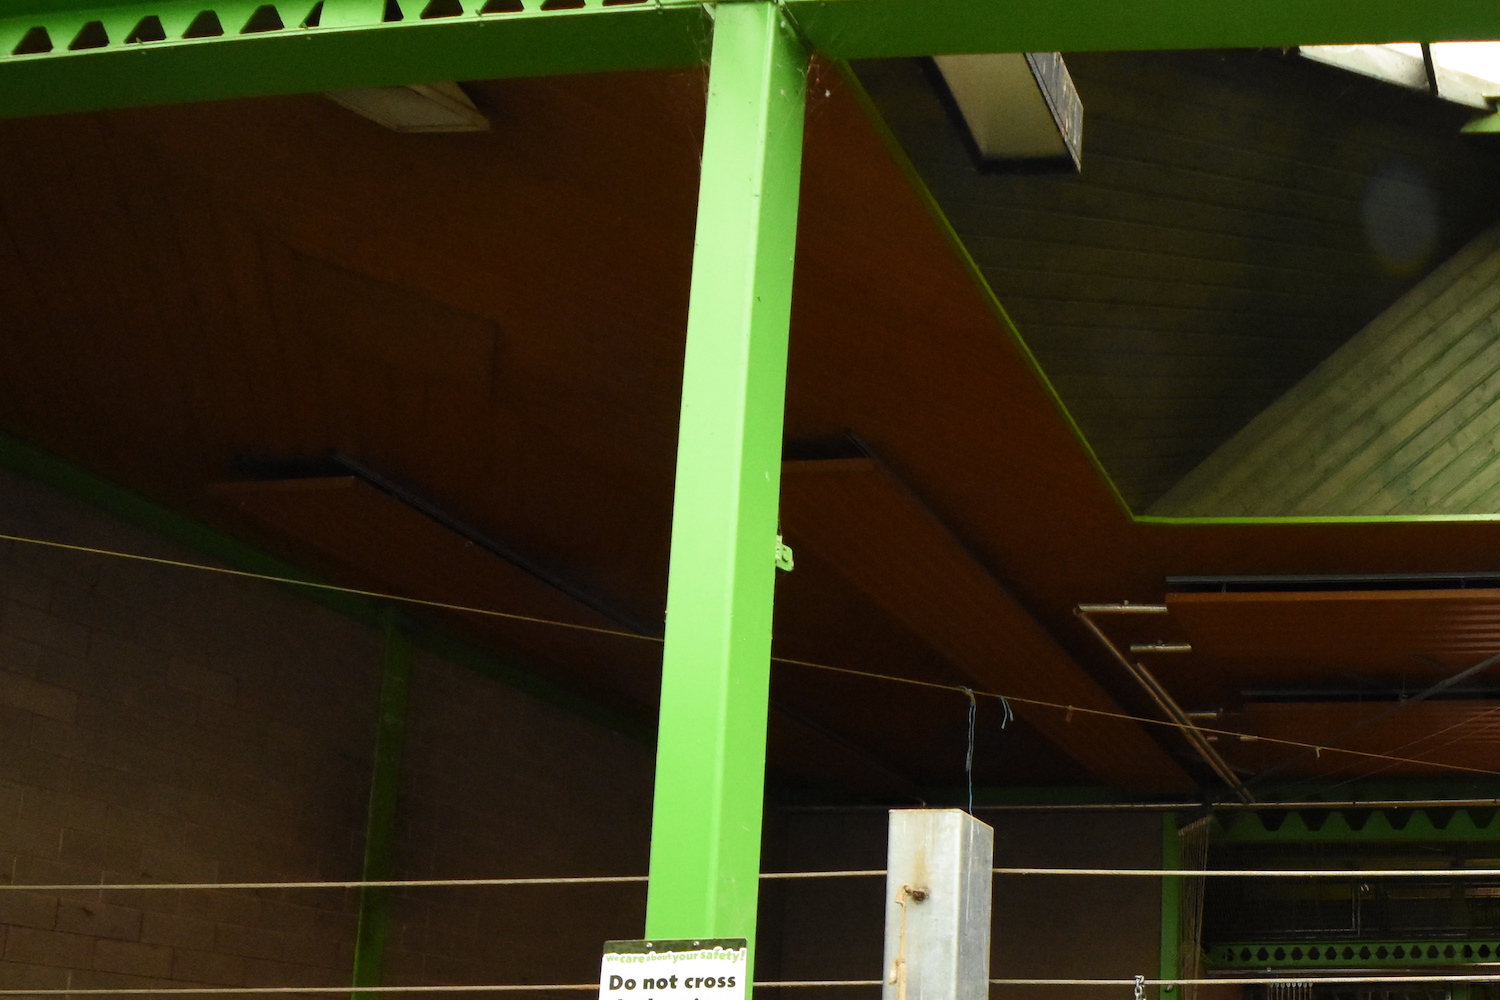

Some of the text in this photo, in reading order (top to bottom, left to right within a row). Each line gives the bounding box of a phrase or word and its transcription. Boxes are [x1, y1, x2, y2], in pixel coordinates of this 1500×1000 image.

[620, 955, 645, 963] care
[646, 953, 671, 962] about
[672, 953, 698, 964] your
[700, 949, 746, 964] safety!
[609, 974, 736, 991] Do not cross
